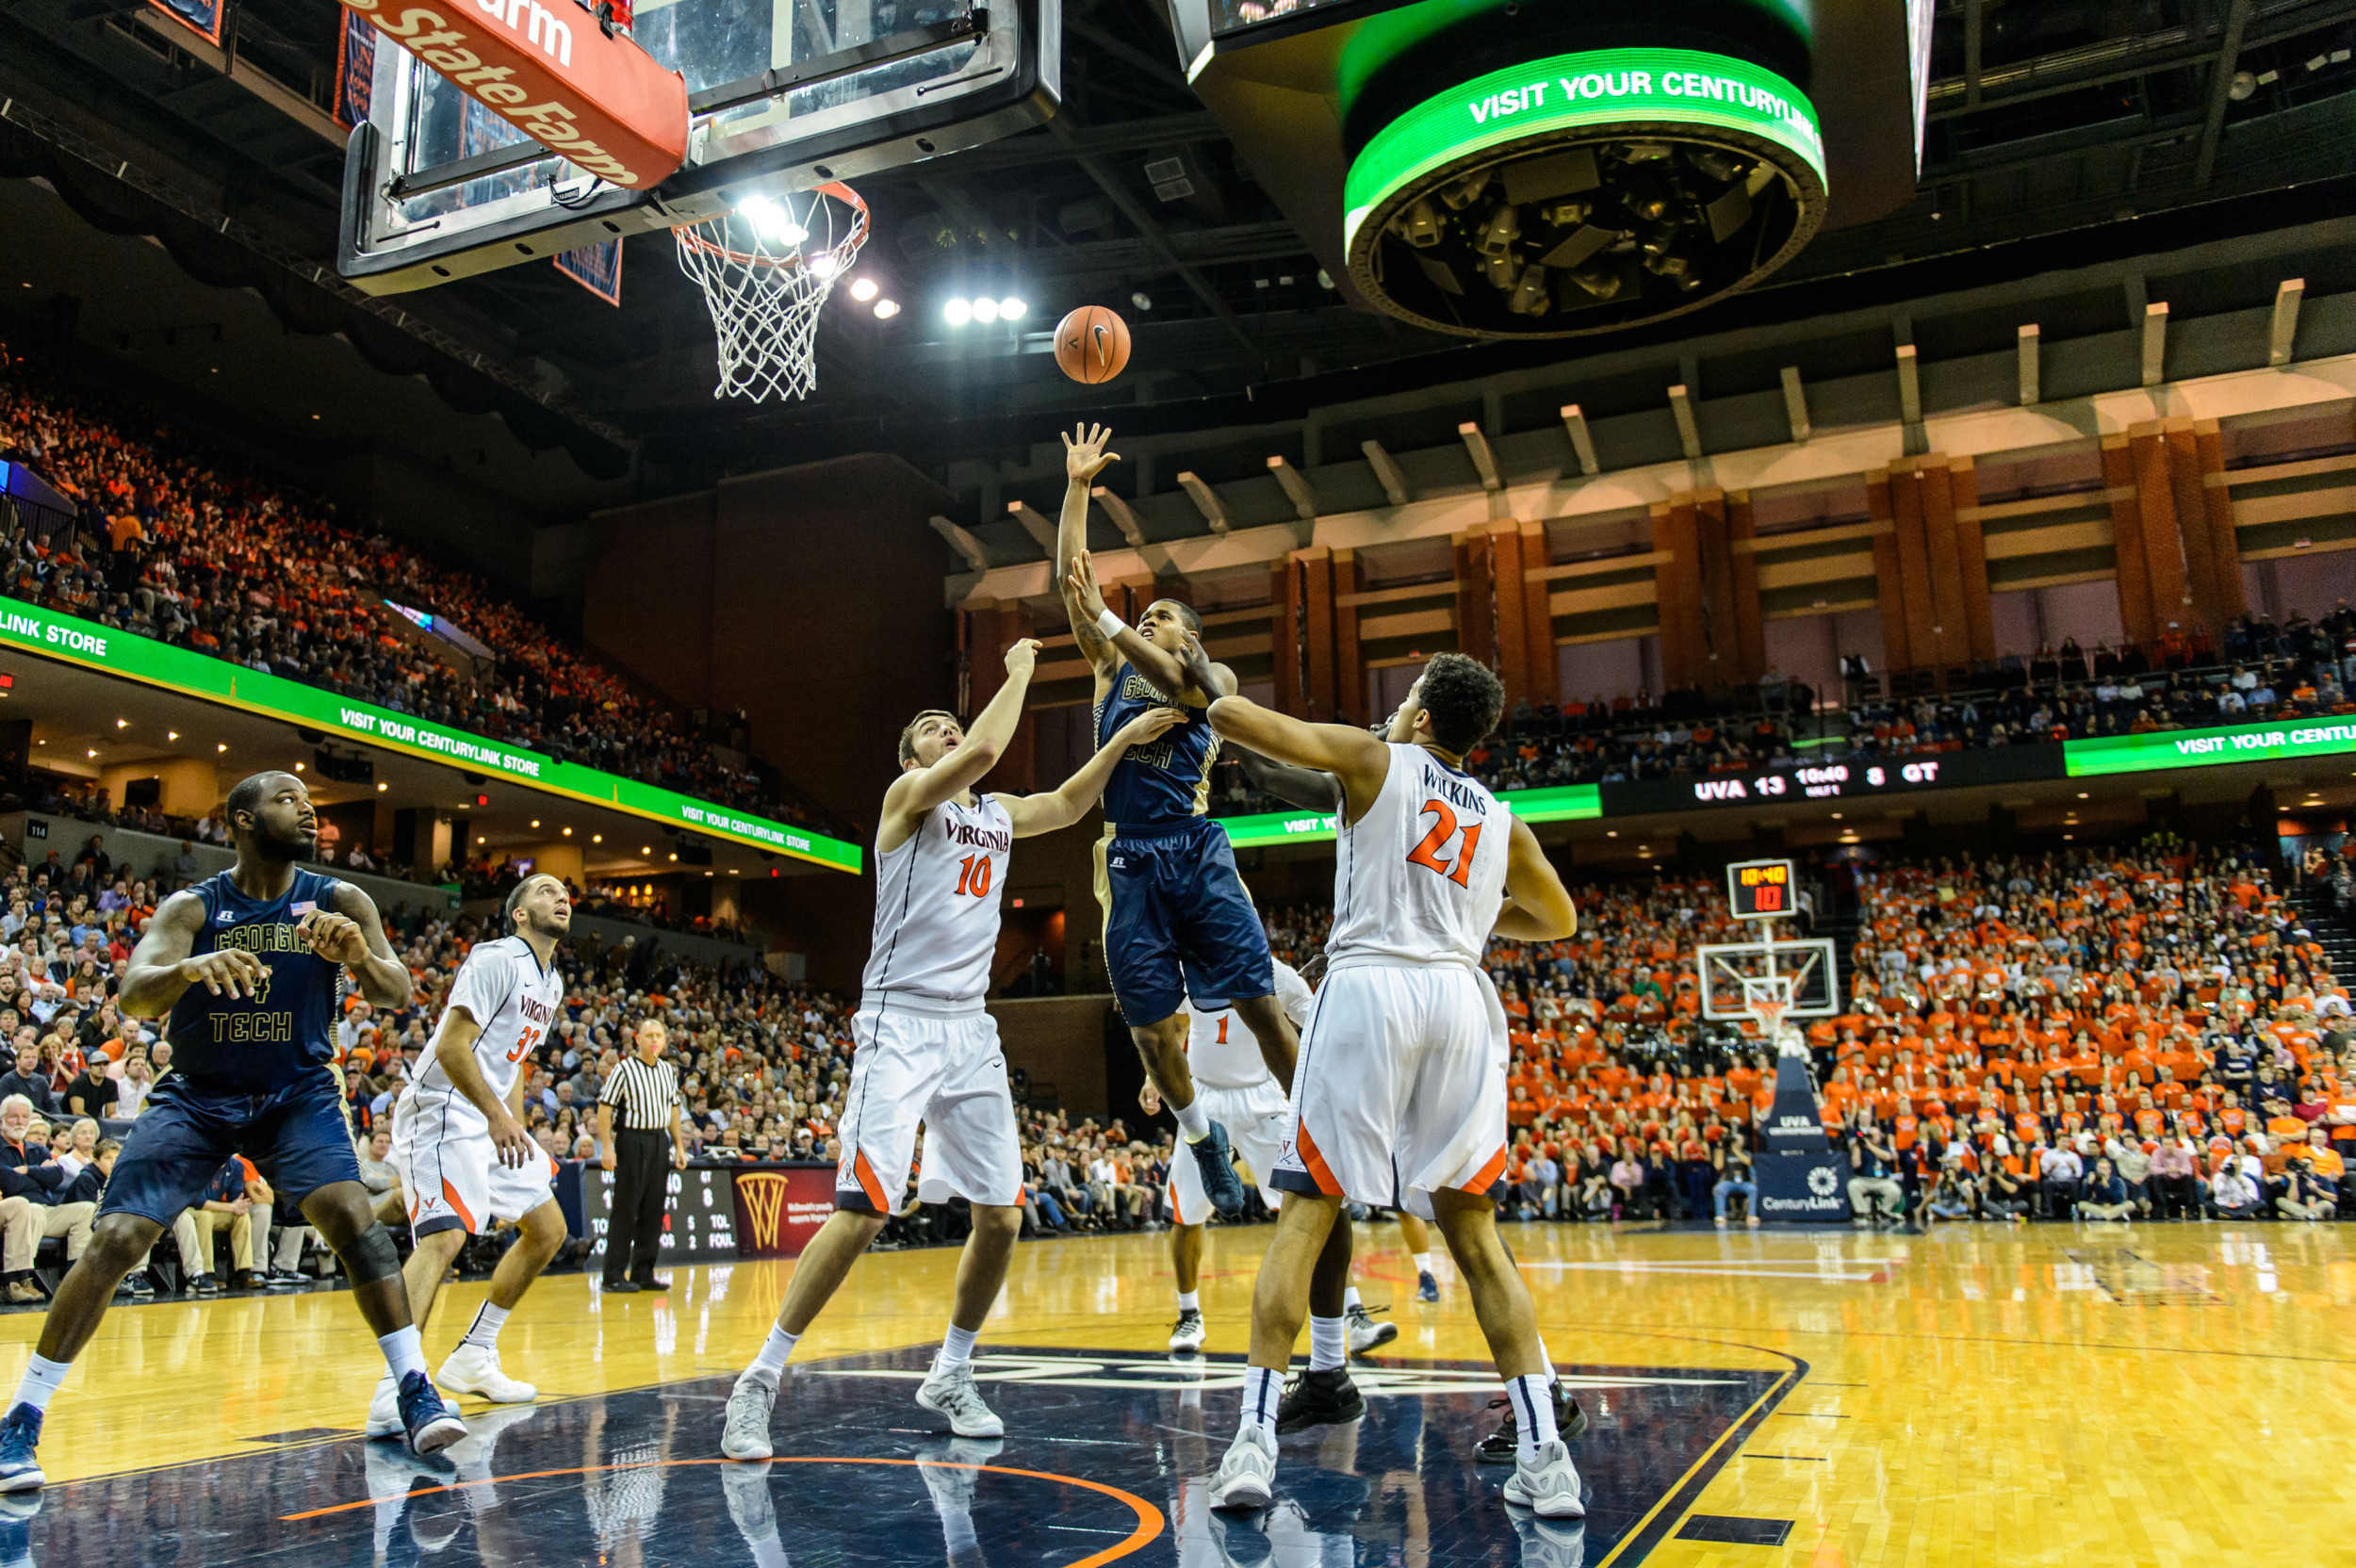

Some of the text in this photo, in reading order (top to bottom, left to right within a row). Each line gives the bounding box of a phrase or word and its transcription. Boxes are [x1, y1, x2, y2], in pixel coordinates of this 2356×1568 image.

[369, 8, 528, 105] State
[501, 101, 639, 185] Farm
[1468, 82, 1549, 124] VISIT
[1560, 71, 1652, 101] YOUR
[46, 625, 106, 657] STORE
[340, 708, 540, 777] VISIT YOUR CENTURYLINK STORE
[2175, 737, 2226, 755] VISIT
[2230, 731, 2286, 750] YOUR
[1424, 763, 1486, 816] WILKINS
[1694, 761, 1939, 801] UVA 13 10:40 8 GT
[681, 805, 810, 852] VISIT YOUR CENTURYLINK STORE
[945, 817, 1009, 853] VIRGINIA
[1284, 818, 1318, 833] VISIT
[1406, 799, 1482, 890] 21
[954, 852, 991, 898] 10
[1741, 866, 1788, 887] 10:40
[1755, 886, 1782, 911] 10
[208, 1011, 292, 1043] TECH
[1216, 1014, 1229, 1045] 1
[1779, 1115, 1811, 1128] UVA
[702, 1186, 714, 1208] 8
[1761, 1195, 1841, 1212] CenturyLink
[687, 1215, 695, 1232] 5
[688, 1233, 697, 1250] 2
[708, 1232, 736, 1249] FOUL
